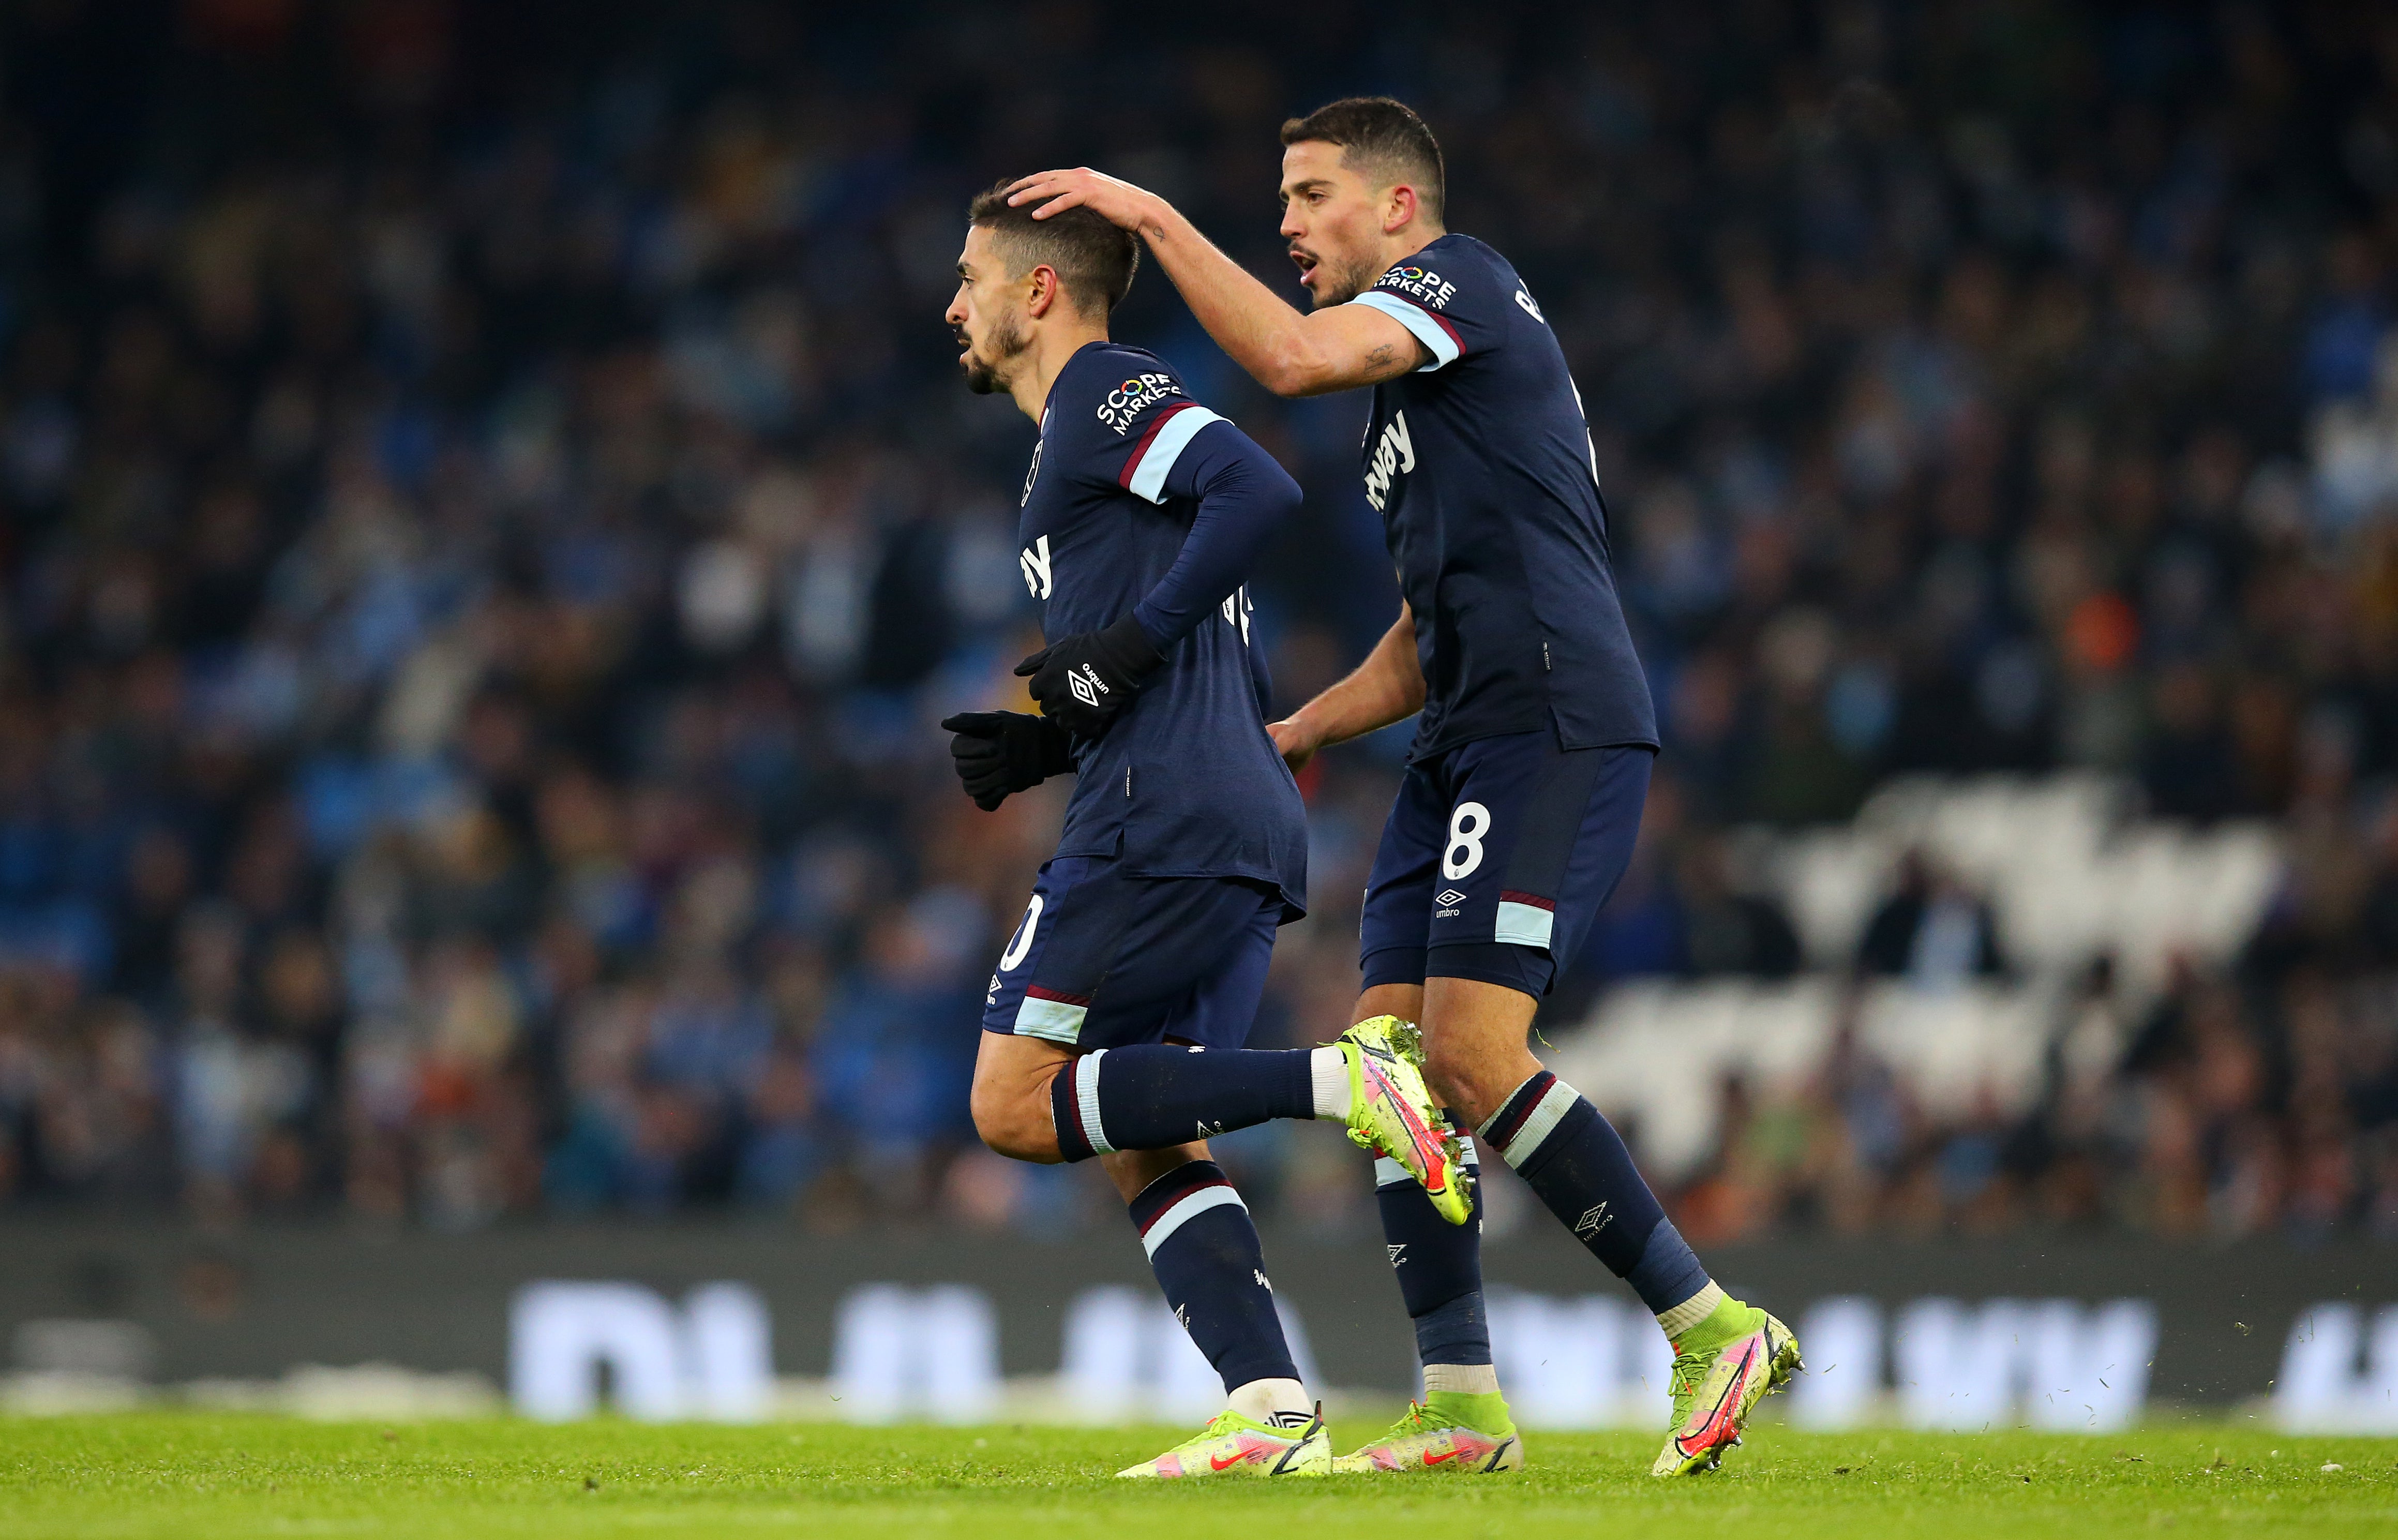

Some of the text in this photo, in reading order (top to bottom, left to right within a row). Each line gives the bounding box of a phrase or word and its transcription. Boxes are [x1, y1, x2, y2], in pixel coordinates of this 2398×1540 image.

[1097, 373, 1170, 425] SCOPE
[1082, 663, 1109, 694] umbro
[1442, 802, 1491, 880] 8
[1000, 894, 1044, 971] 0
[1436, 907, 1460, 918] umbro
